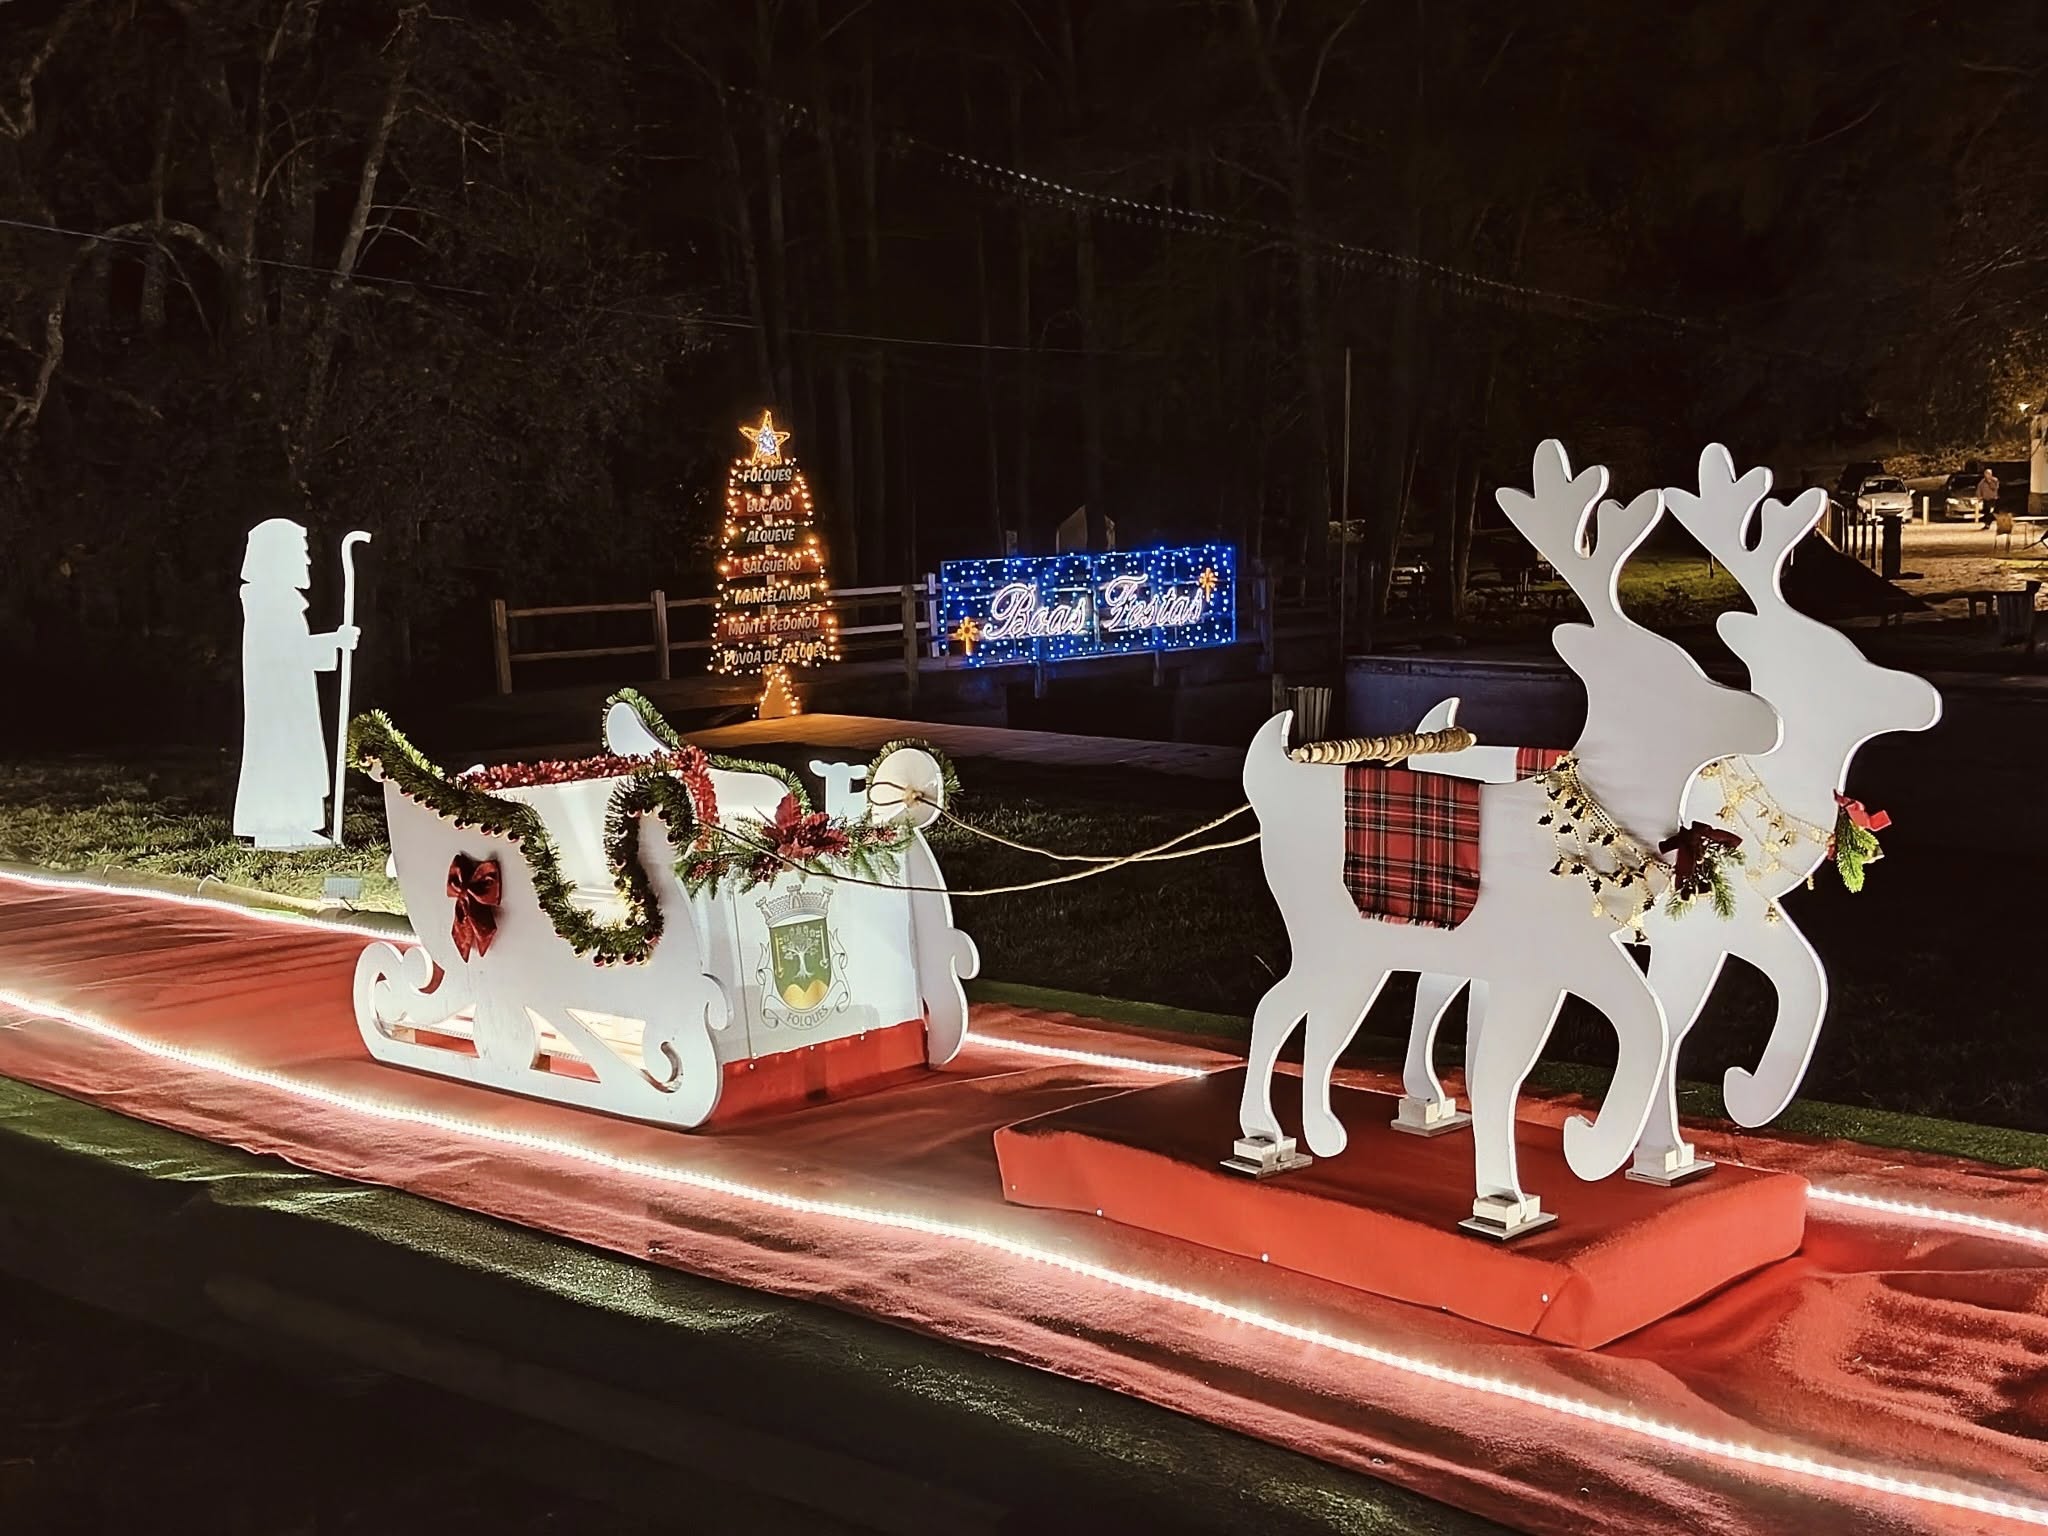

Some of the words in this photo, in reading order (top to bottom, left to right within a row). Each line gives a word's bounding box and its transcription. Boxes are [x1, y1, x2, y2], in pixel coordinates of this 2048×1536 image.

[743, 467, 792, 482] FOLQUES
[746, 529, 795, 543] ALQUEVE
[742, 560, 801, 574] SALGUEIRO
[983, 582, 1086, 640] Boas
[1103, 573, 1202, 633] Festas
[728, 619, 766, 636] MONTE
[769, 614, 819, 632] REDONDO
[764, 648, 779, 662] DE
[786, 1004, 829, 1027] FOLQUES
